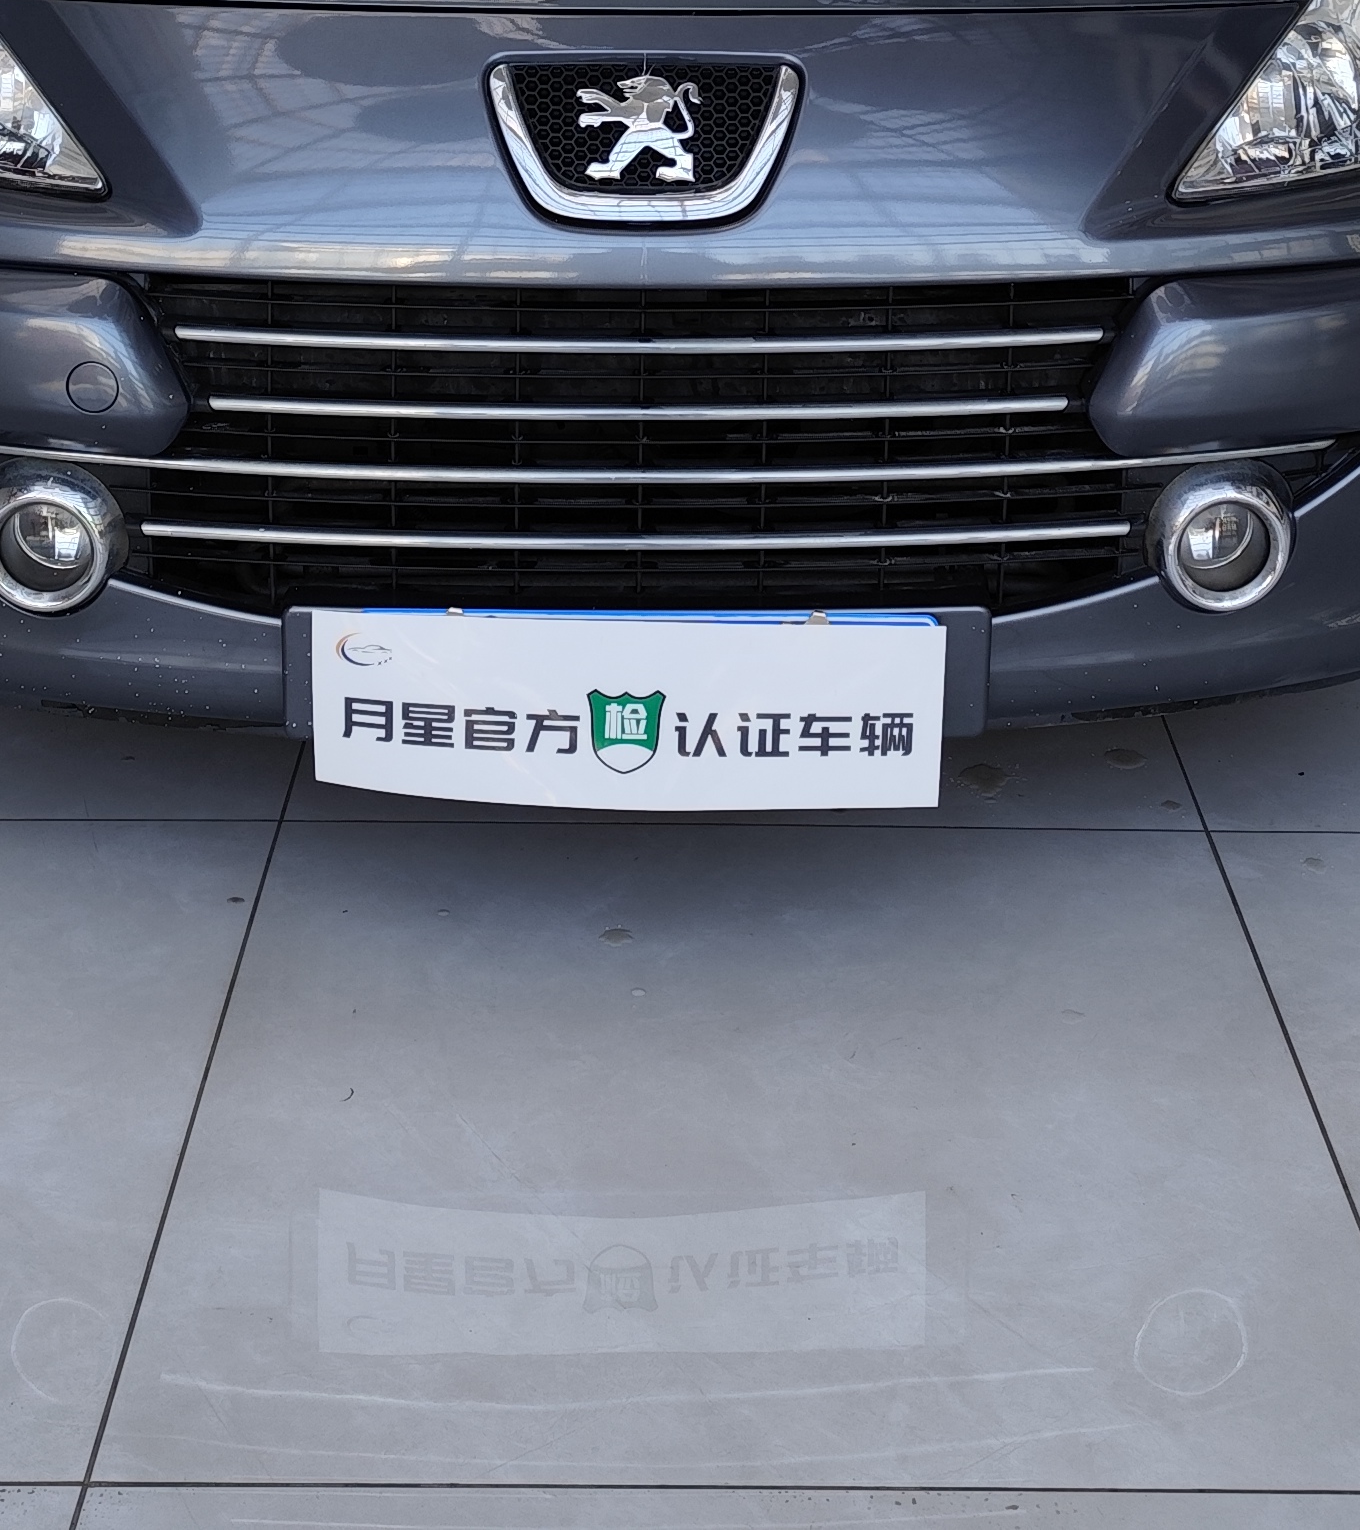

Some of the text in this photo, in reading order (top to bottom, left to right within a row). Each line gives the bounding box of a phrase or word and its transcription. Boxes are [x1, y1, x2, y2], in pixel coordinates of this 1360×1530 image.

[342, 695, 915, 760] 月星官方 检 认证车辆
